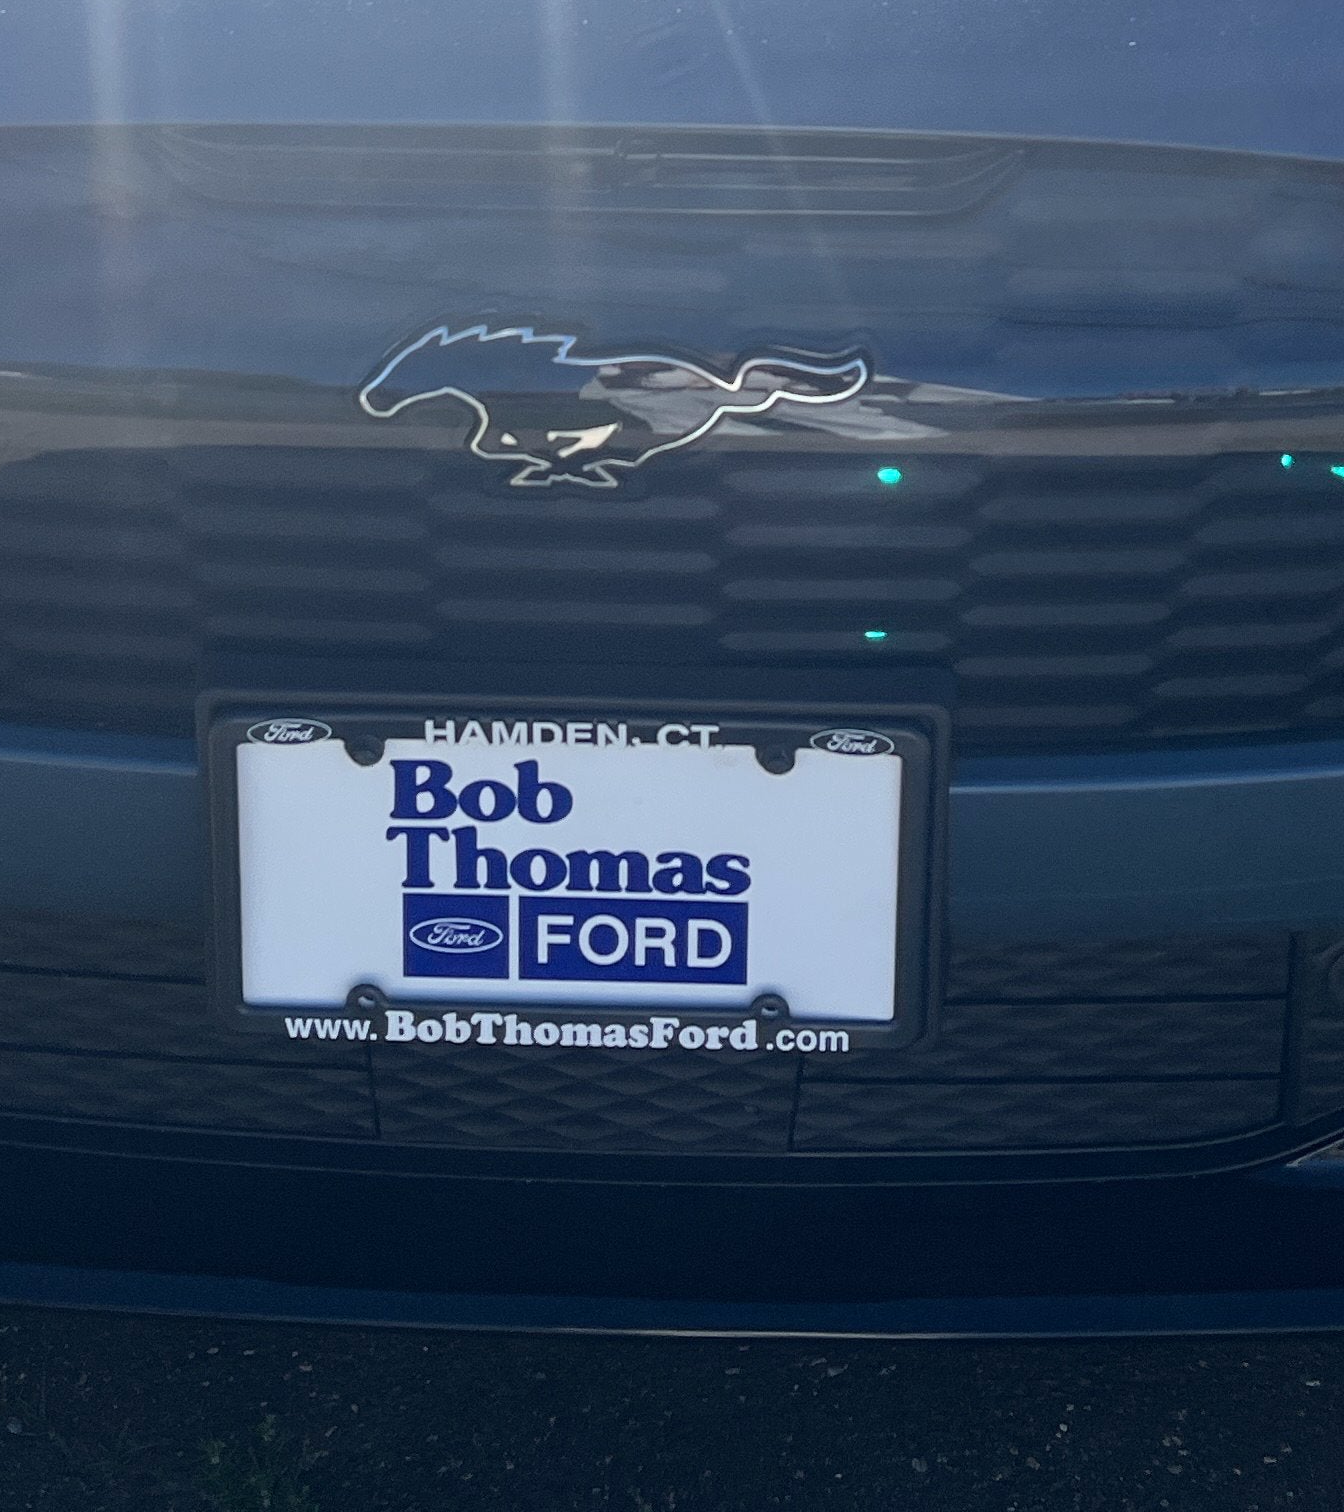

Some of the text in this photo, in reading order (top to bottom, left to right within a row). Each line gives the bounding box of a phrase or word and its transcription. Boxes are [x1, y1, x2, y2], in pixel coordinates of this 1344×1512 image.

[263, 722, 315, 742] Ford
[826, 734, 878, 754] Ford
[389, 759, 573, 824] Bob
[386, 826, 752, 896] Thomas
[427, 922, 485, 948] Ford
[537, 914, 733, 969] FORD
